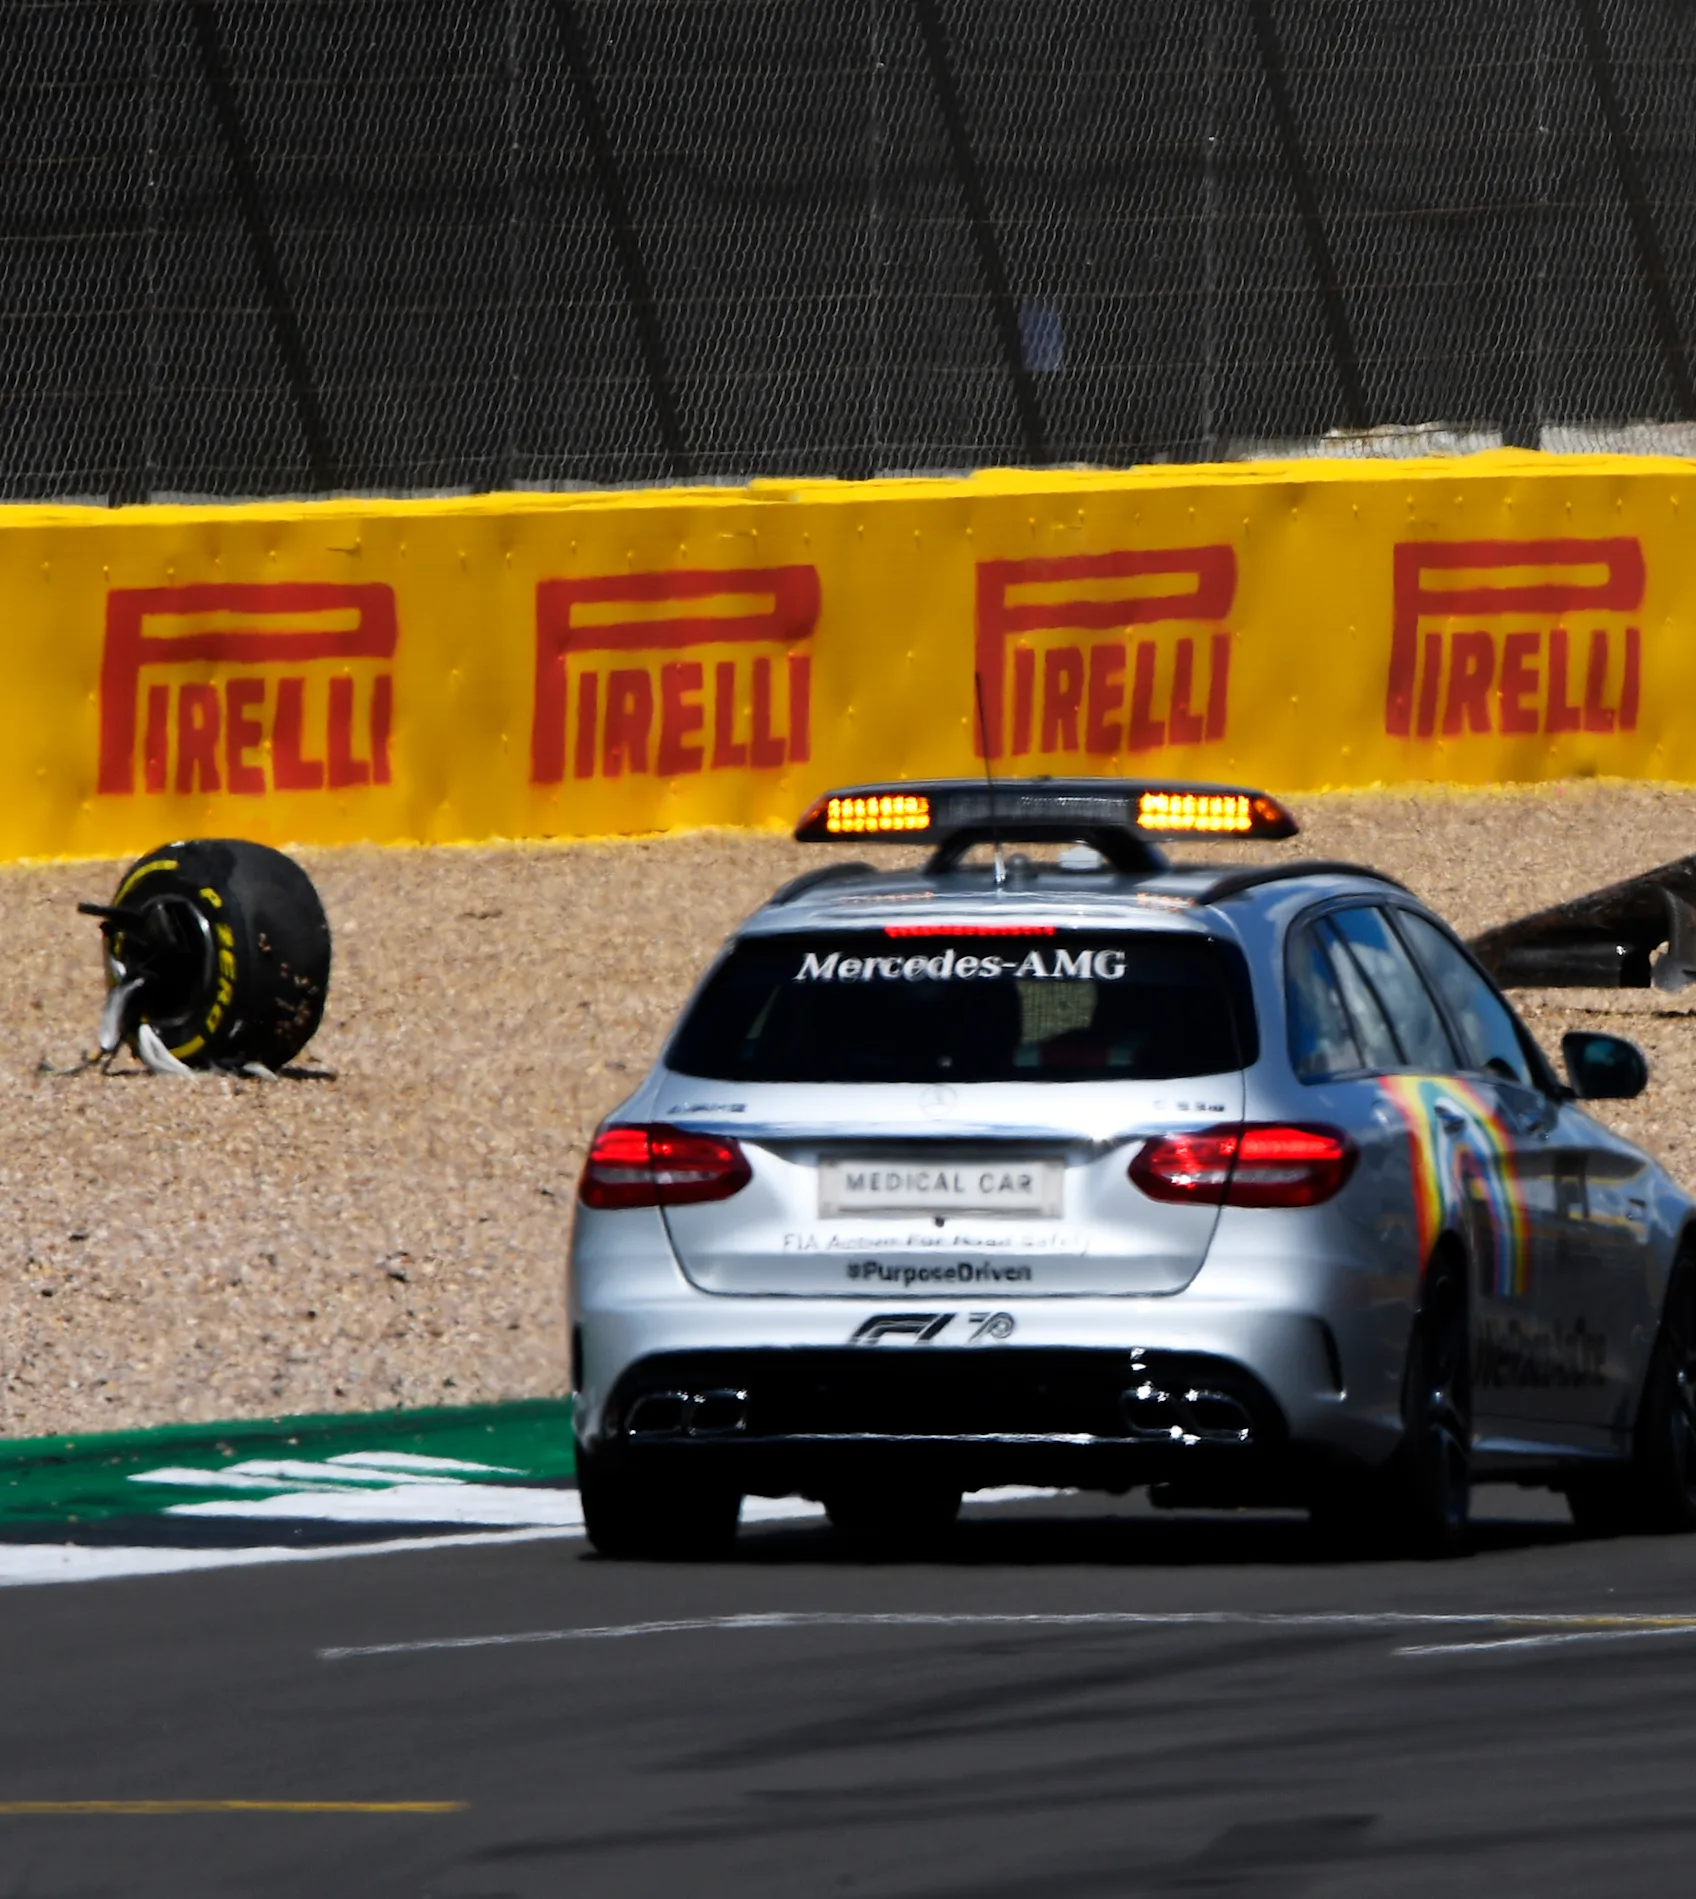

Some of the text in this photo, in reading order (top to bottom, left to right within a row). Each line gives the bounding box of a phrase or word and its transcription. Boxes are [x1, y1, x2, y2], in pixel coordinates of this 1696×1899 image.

[97, 582, 398, 796] PIRELLI
[529, 564, 822, 784] PIRELLI
[975, 544, 1238, 757] PIRELLI
[1385, 536, 1646, 737] PIRELLI
[794, 949, 1127, 982] Mercedes-AMG
[783, 1234, 818, 1249] FIA
[846, 1172, 1032, 1194] MEDICAL CAR
[847, 1260, 1032, 1287] #PurposeDriven
